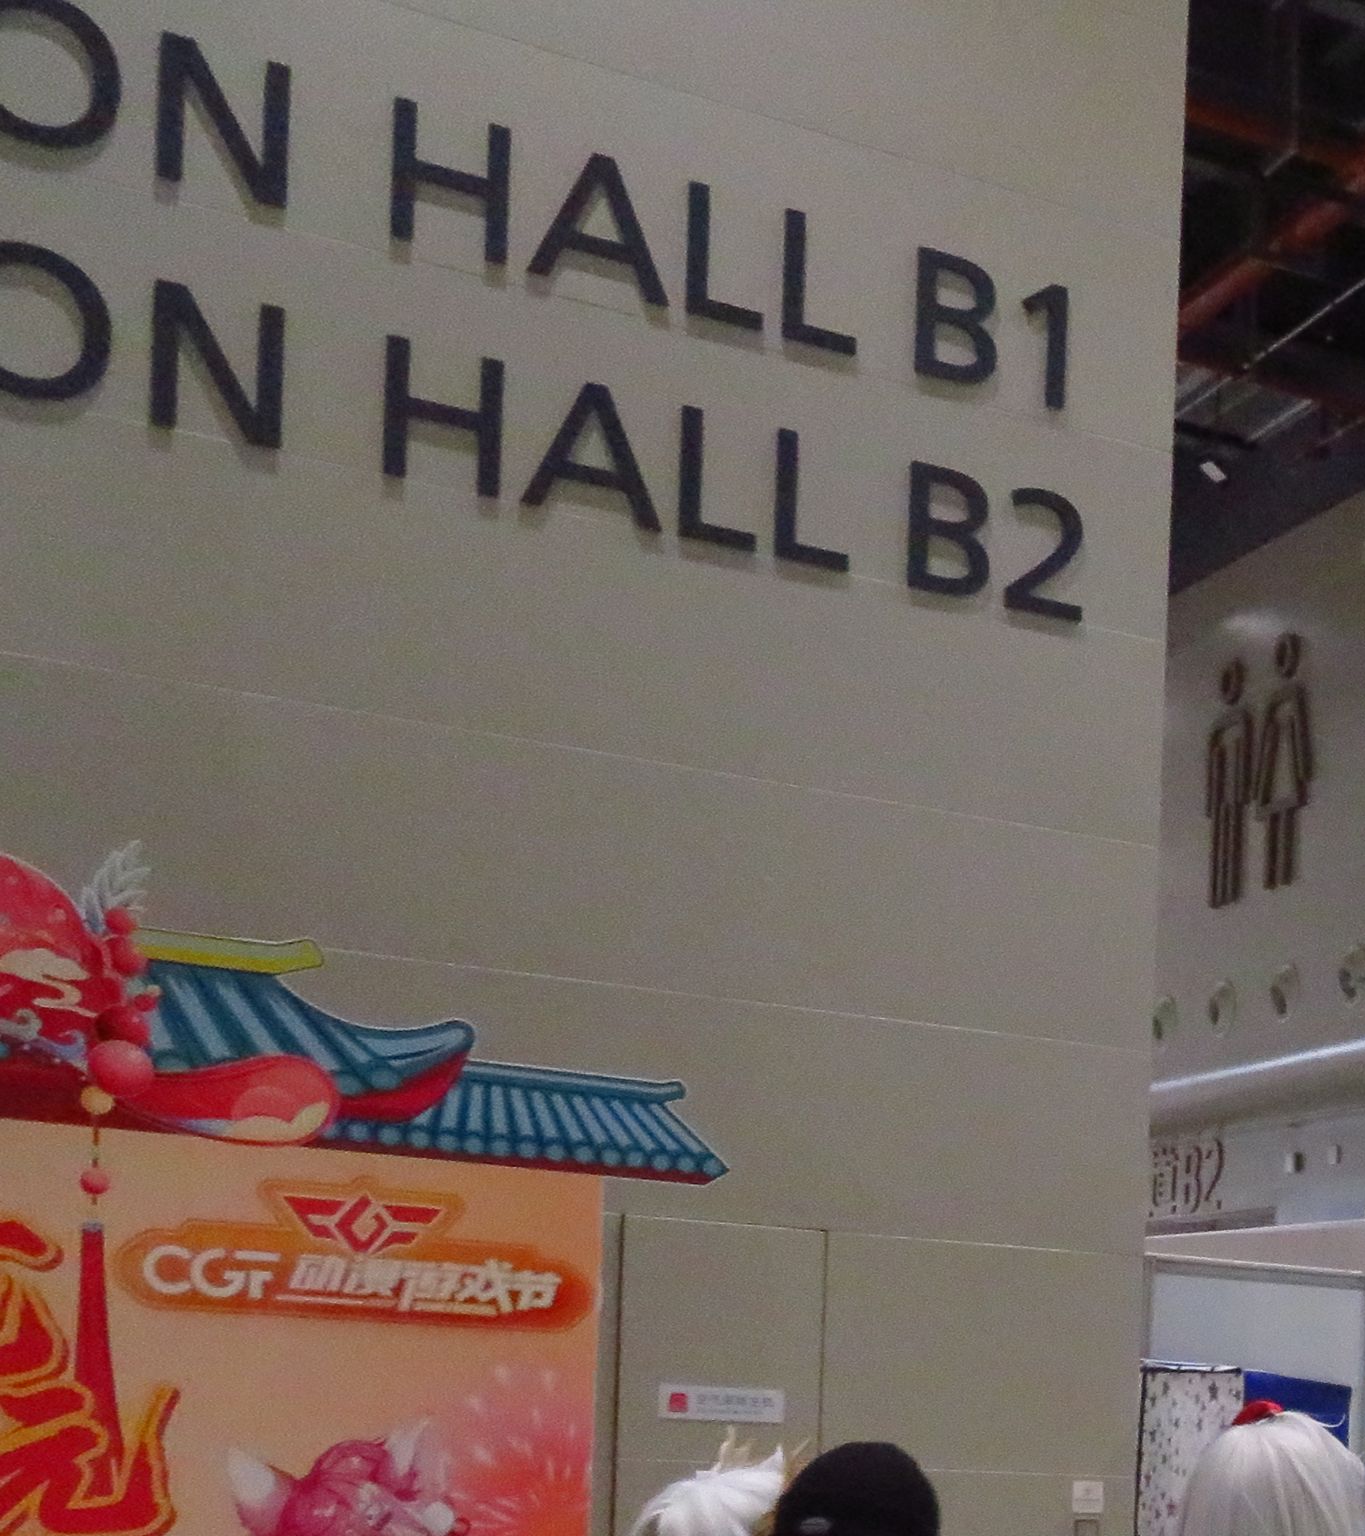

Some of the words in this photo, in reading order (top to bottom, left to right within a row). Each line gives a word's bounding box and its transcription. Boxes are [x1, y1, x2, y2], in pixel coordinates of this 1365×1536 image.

[0, 0, 291, 209] ON
[390, 97, 858, 356] HALL
[914, 246, 1070, 410] B1
[0, 240, 285, 450] ON
[382, 334, 850, 573] HALL
[906, 460, 1084, 622] B2
